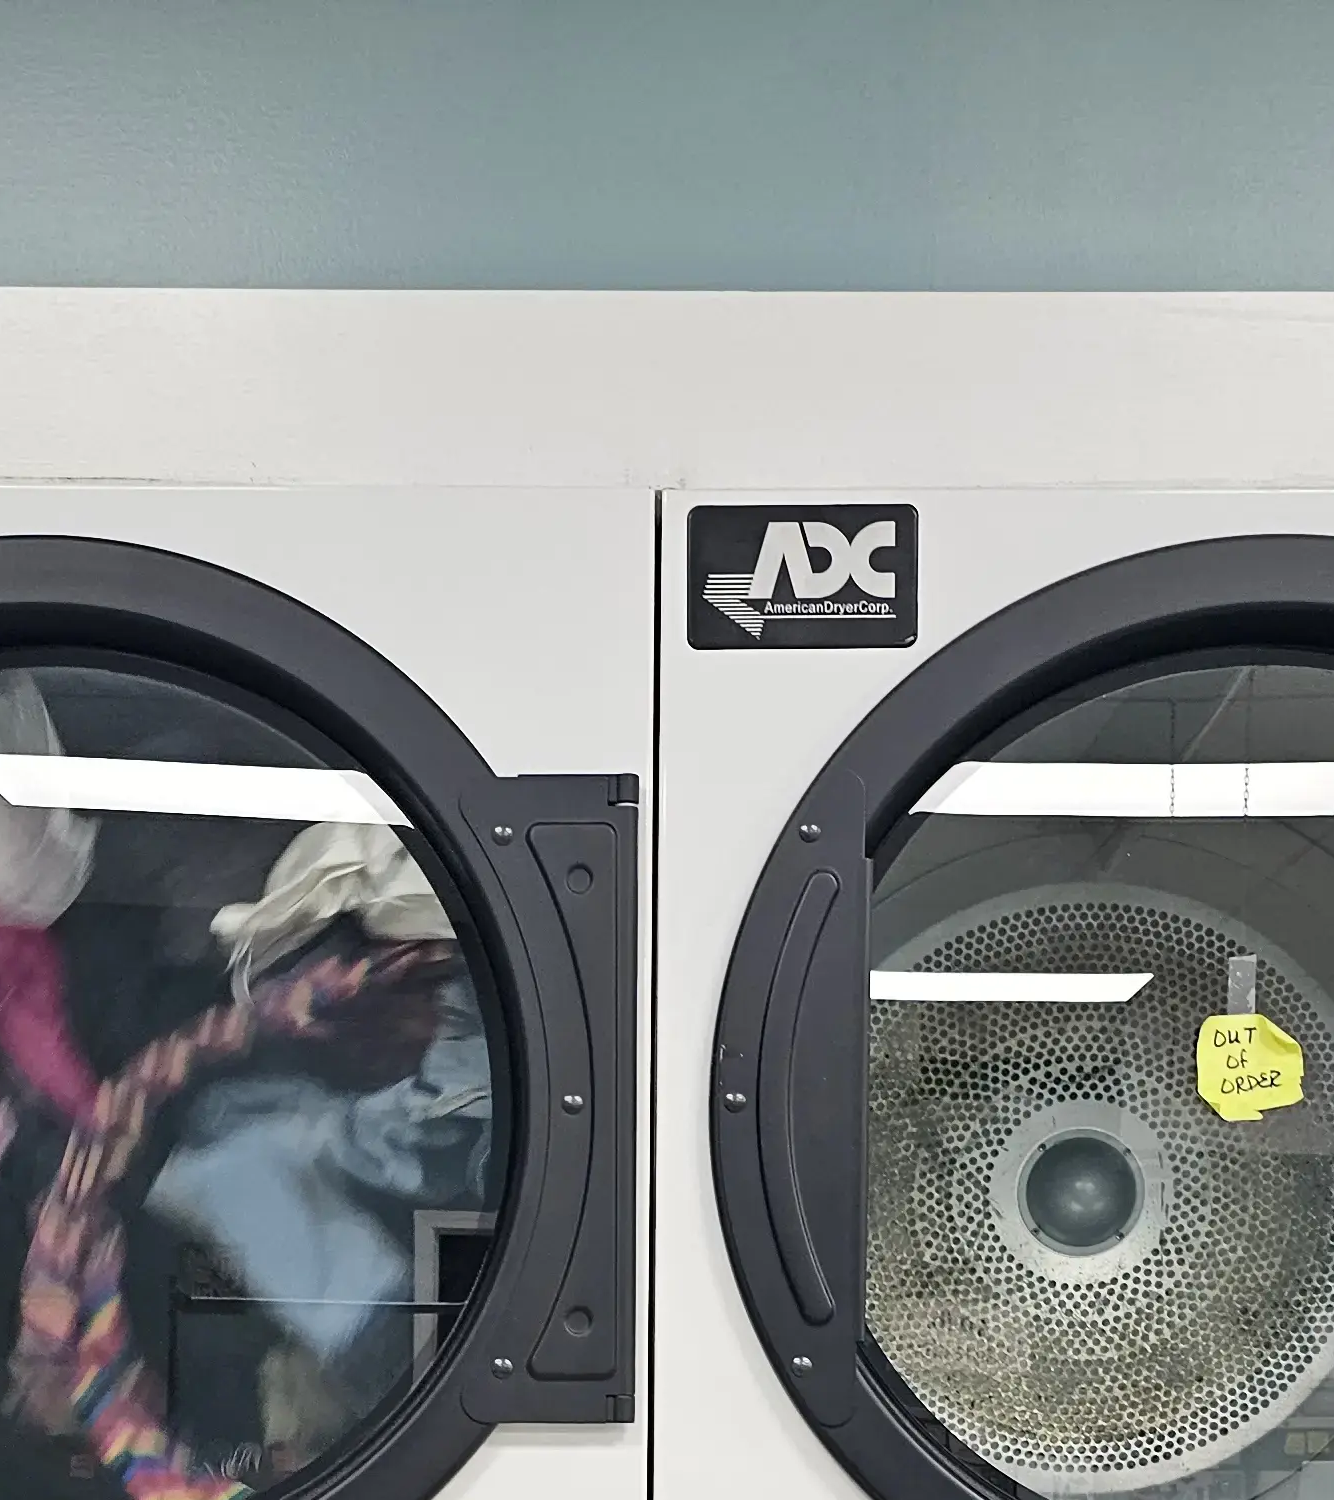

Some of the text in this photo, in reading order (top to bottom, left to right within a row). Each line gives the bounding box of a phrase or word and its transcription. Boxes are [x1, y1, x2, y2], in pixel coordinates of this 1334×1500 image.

[748, 520, 896, 598] ADC
[1213, 1026, 1257, 1048] OUT
[1220, 1069, 1283, 1094] ORDER
